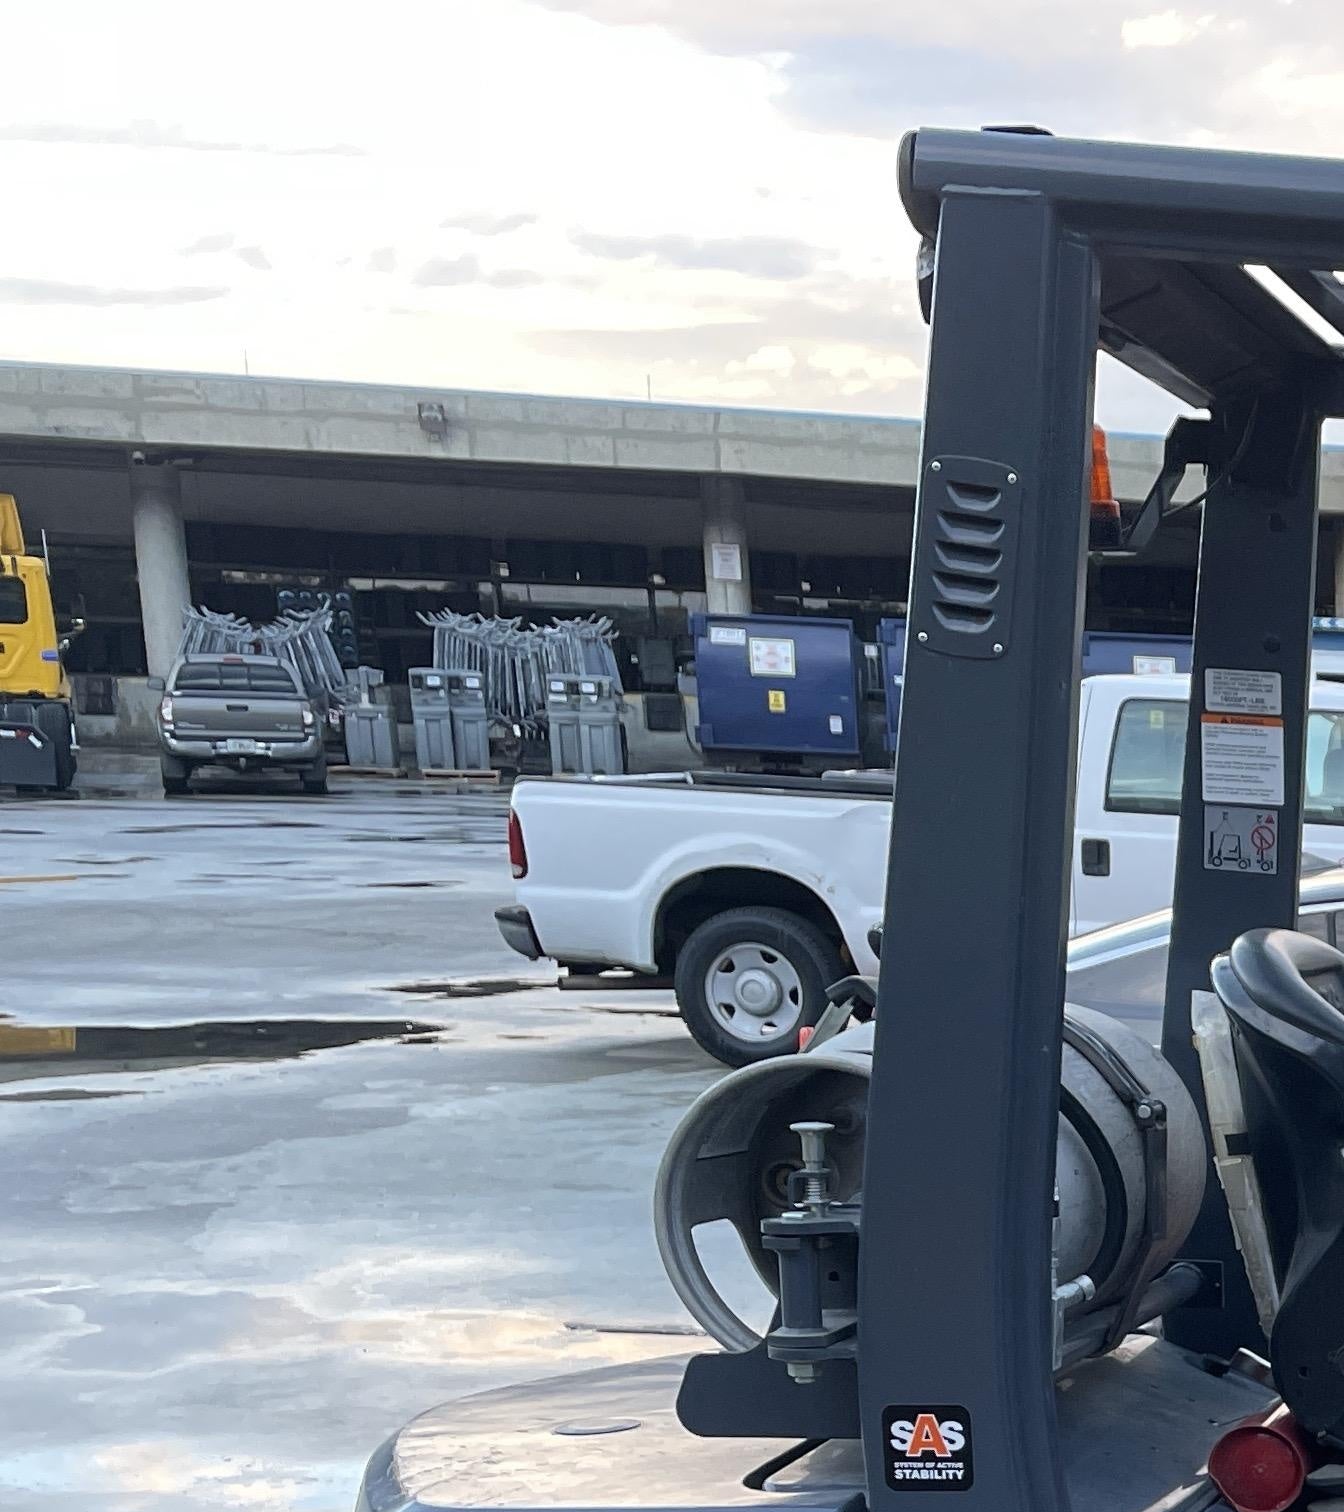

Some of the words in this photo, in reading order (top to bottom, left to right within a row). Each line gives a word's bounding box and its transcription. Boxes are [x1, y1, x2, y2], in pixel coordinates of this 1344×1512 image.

[890, 1413, 966, 1457] SAS
[894, 1461, 924, 1469] SYSTEM
[894, 1469, 965, 1480] STABILITY
